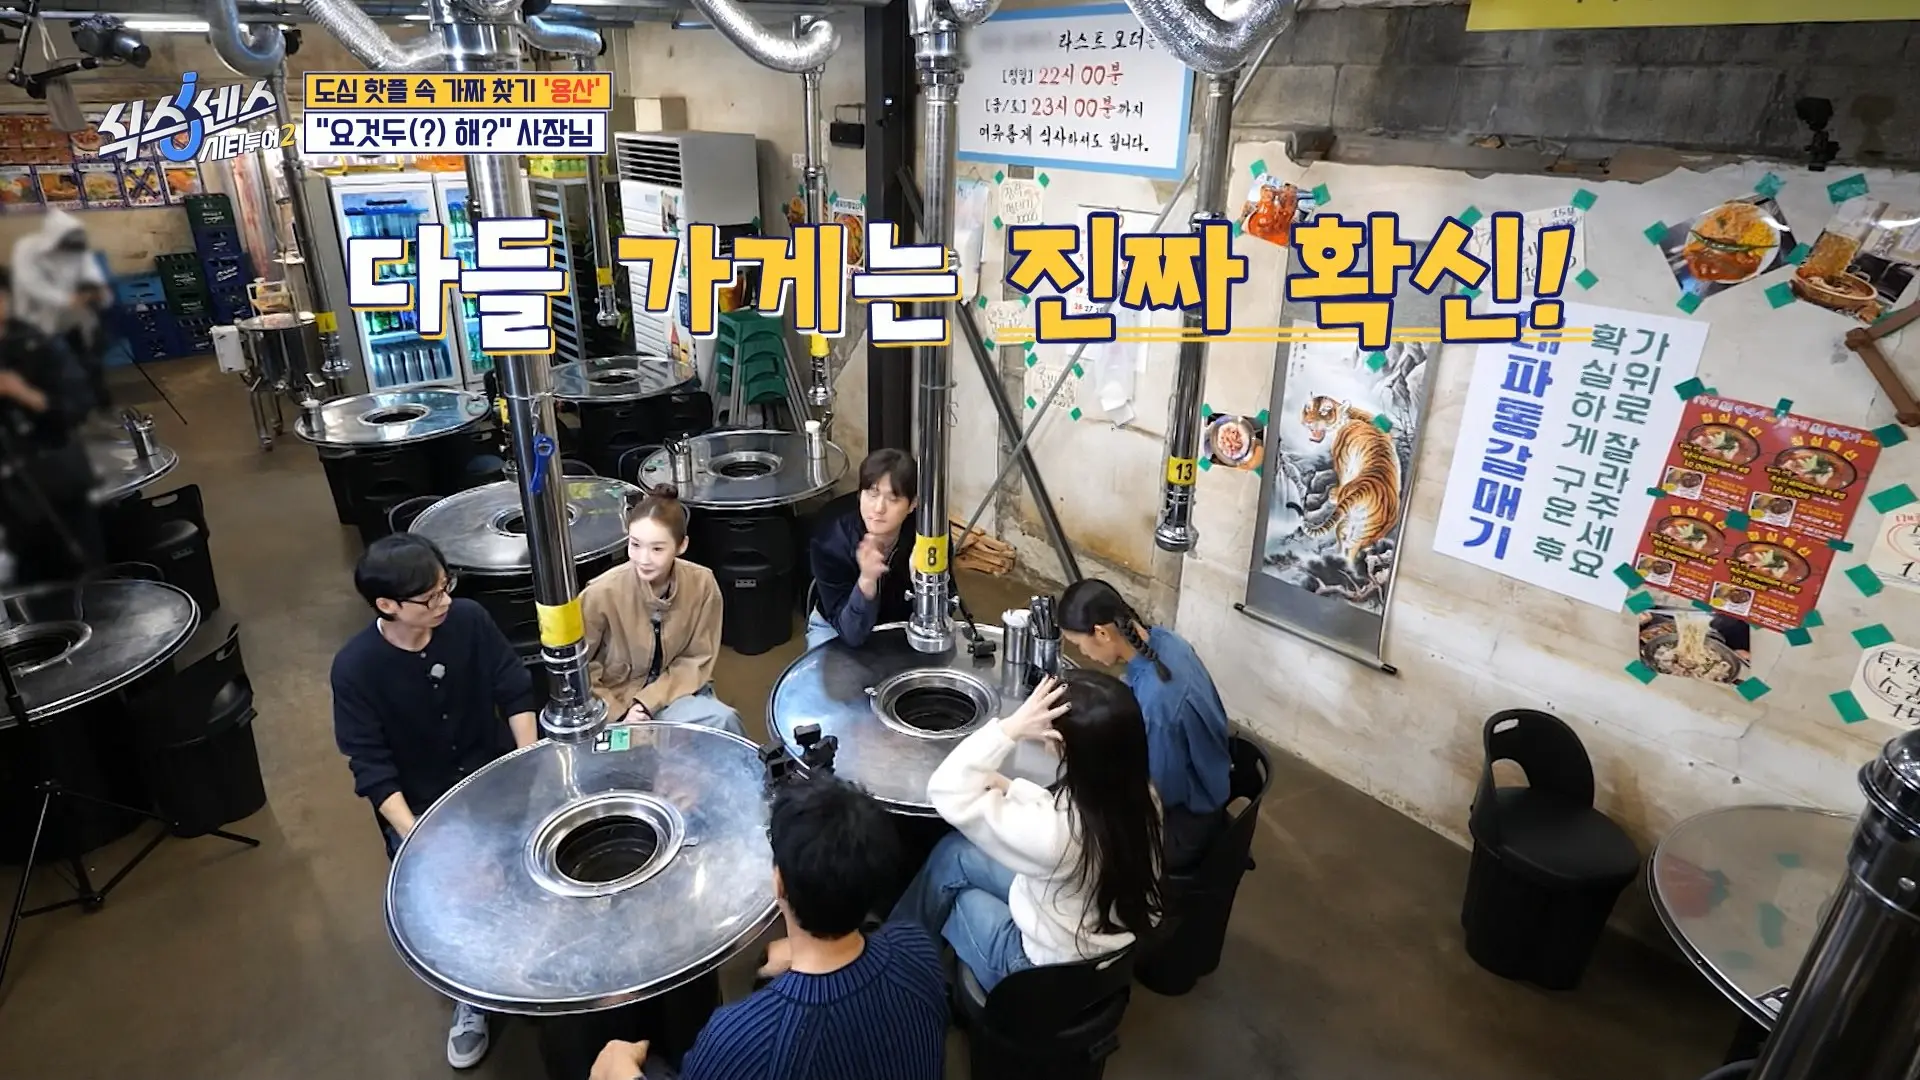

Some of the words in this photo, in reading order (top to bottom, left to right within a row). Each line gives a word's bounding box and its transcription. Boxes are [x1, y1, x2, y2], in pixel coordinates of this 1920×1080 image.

[1059, 30, 1107, 53] 라스트
[1038, 63, 1074, 85] 22시
[1081, 61, 1124, 86] 00분
[1031, 96, 1068, 117] 23시
[1074, 95, 1143, 119] 00분까지
[979, 123, 1032, 145] 여유롭게
[1562, 323, 1628, 456] 확실하게
[1612, 328, 1671, 426] 가위로
[1175, 463, 1193, 481] 13
[1543, 465, 1586, 527] 구운
[1569, 431, 1641, 579] 잘라주세요
[927, 547, 937, 566] 8
[1533, 536, 1567, 563] 후
